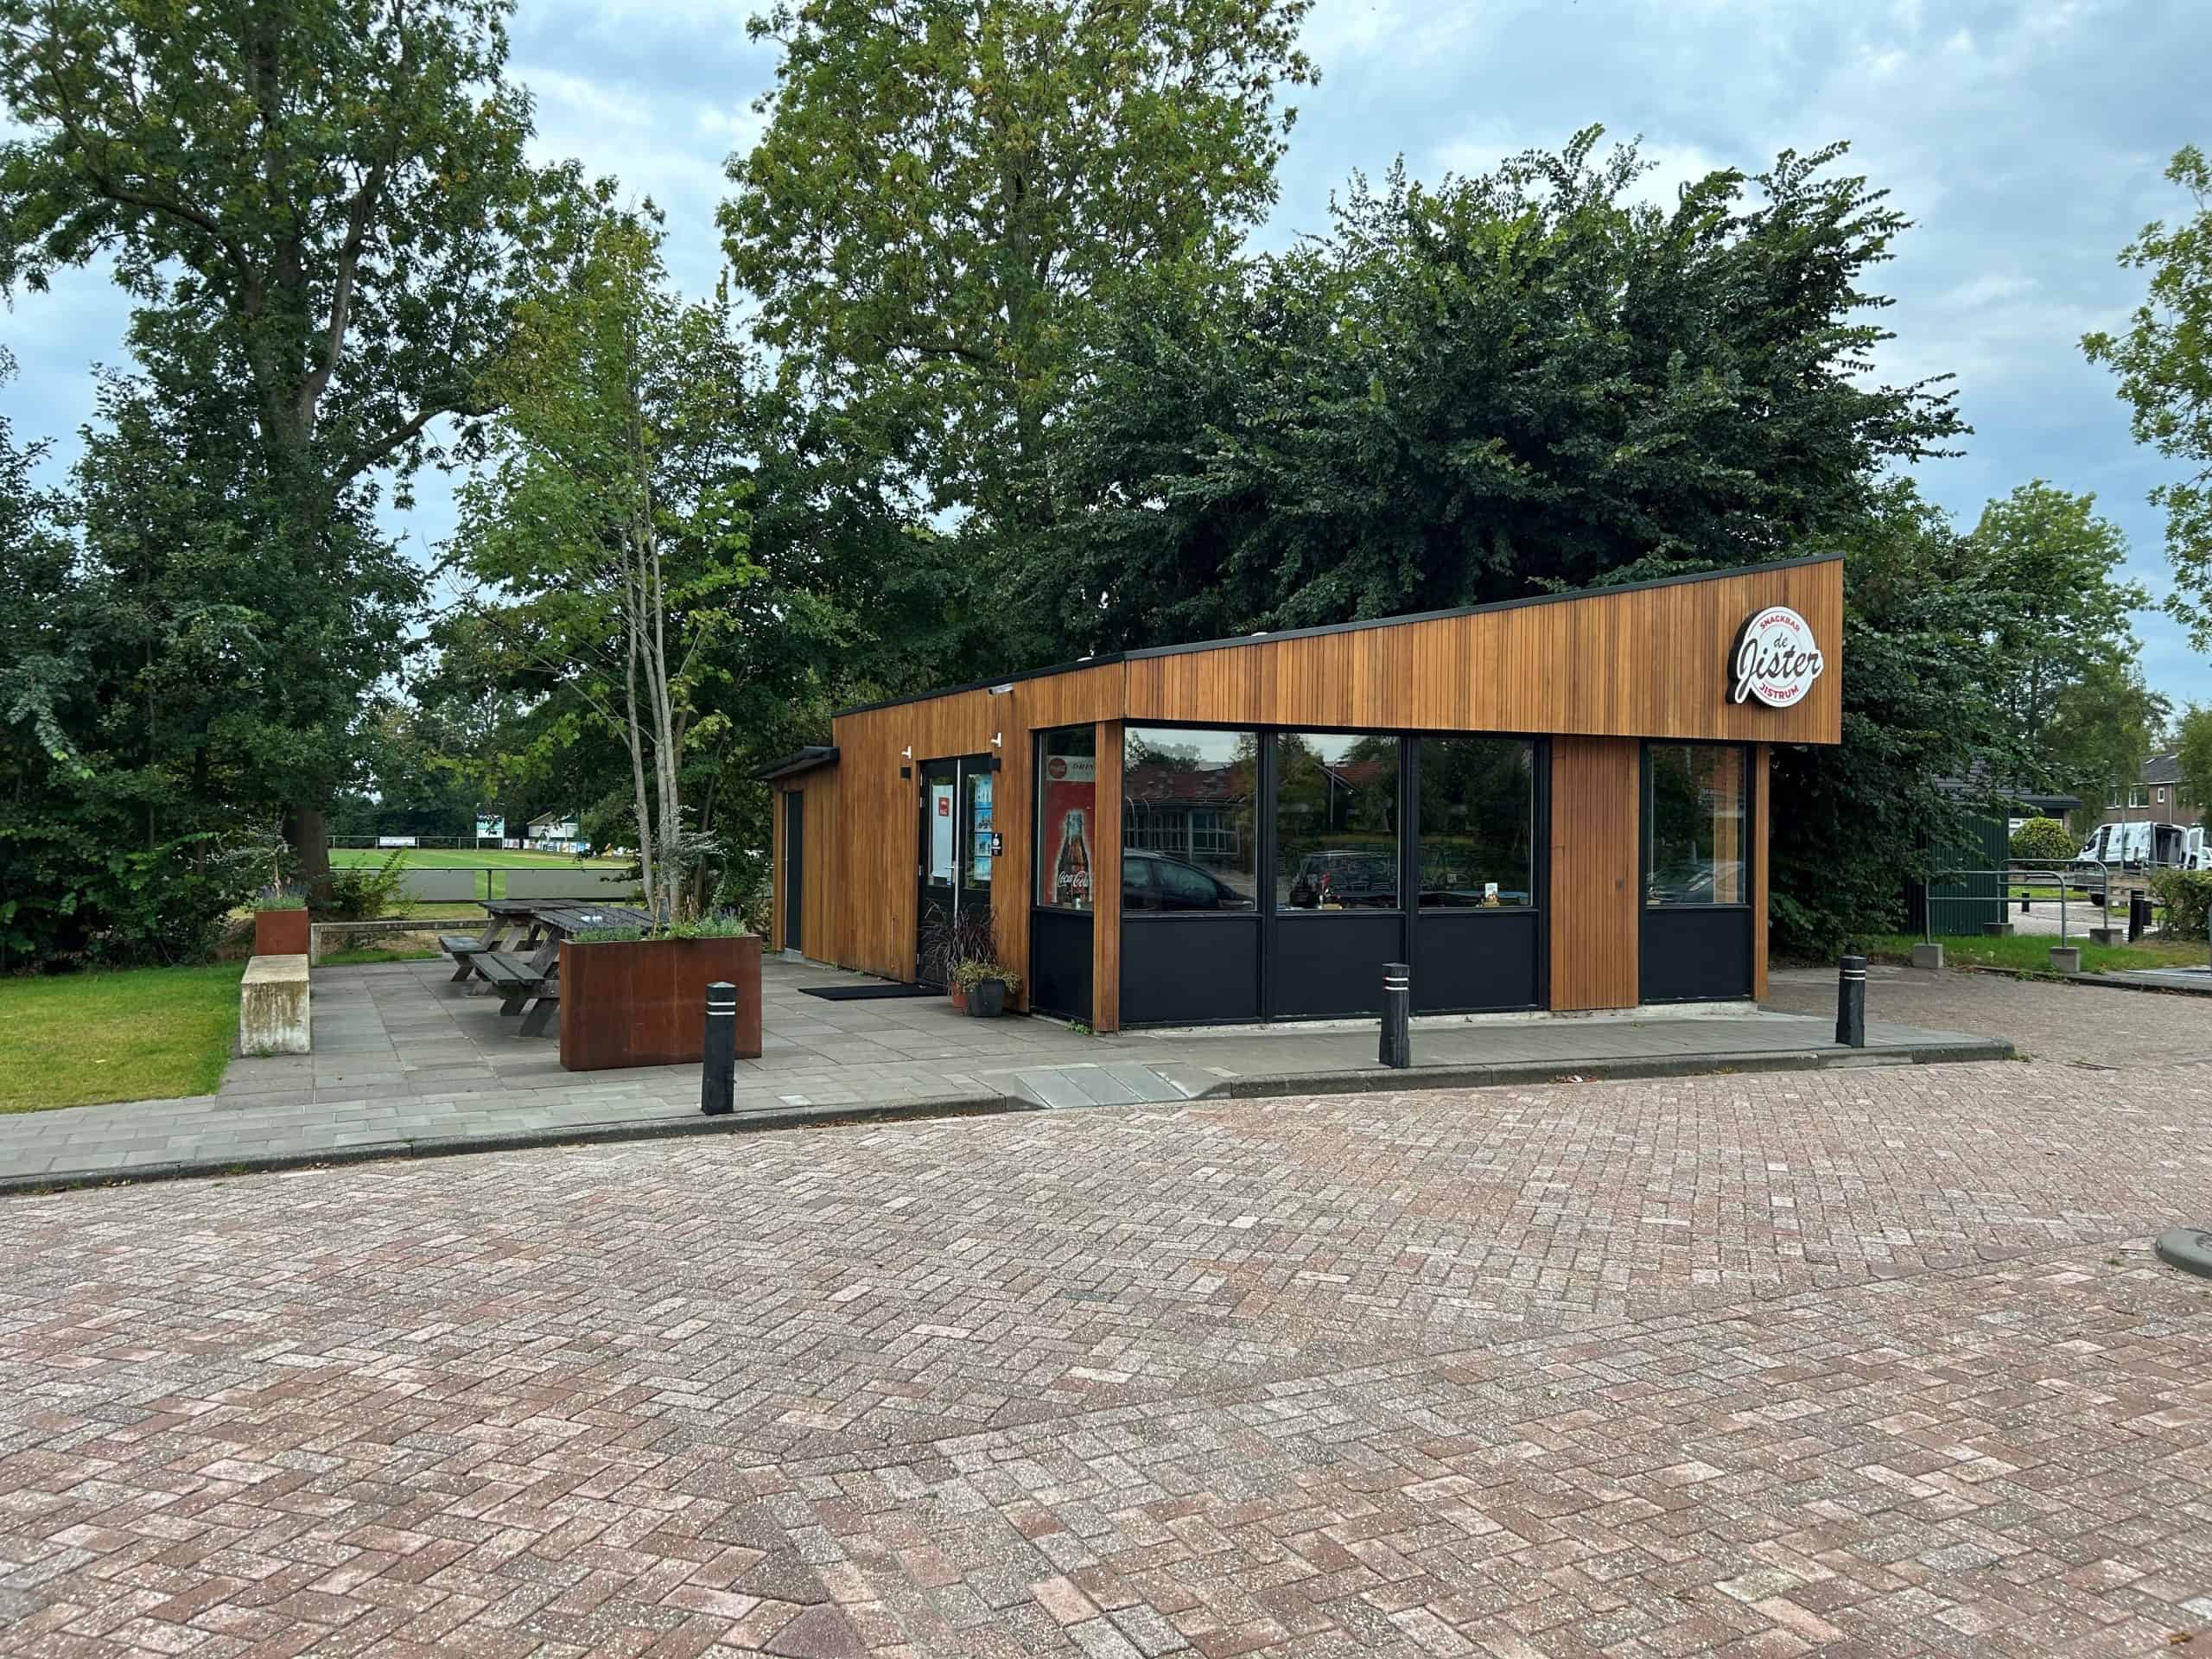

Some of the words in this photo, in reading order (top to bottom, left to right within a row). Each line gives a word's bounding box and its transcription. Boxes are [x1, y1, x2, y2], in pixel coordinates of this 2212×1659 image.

[1759, 615, 1801, 632] SNACKBAR
[1774, 632, 1788, 648] de
[1737, 638, 1821, 700] Jister
[1759, 683, 1799, 699] JISTRUM
